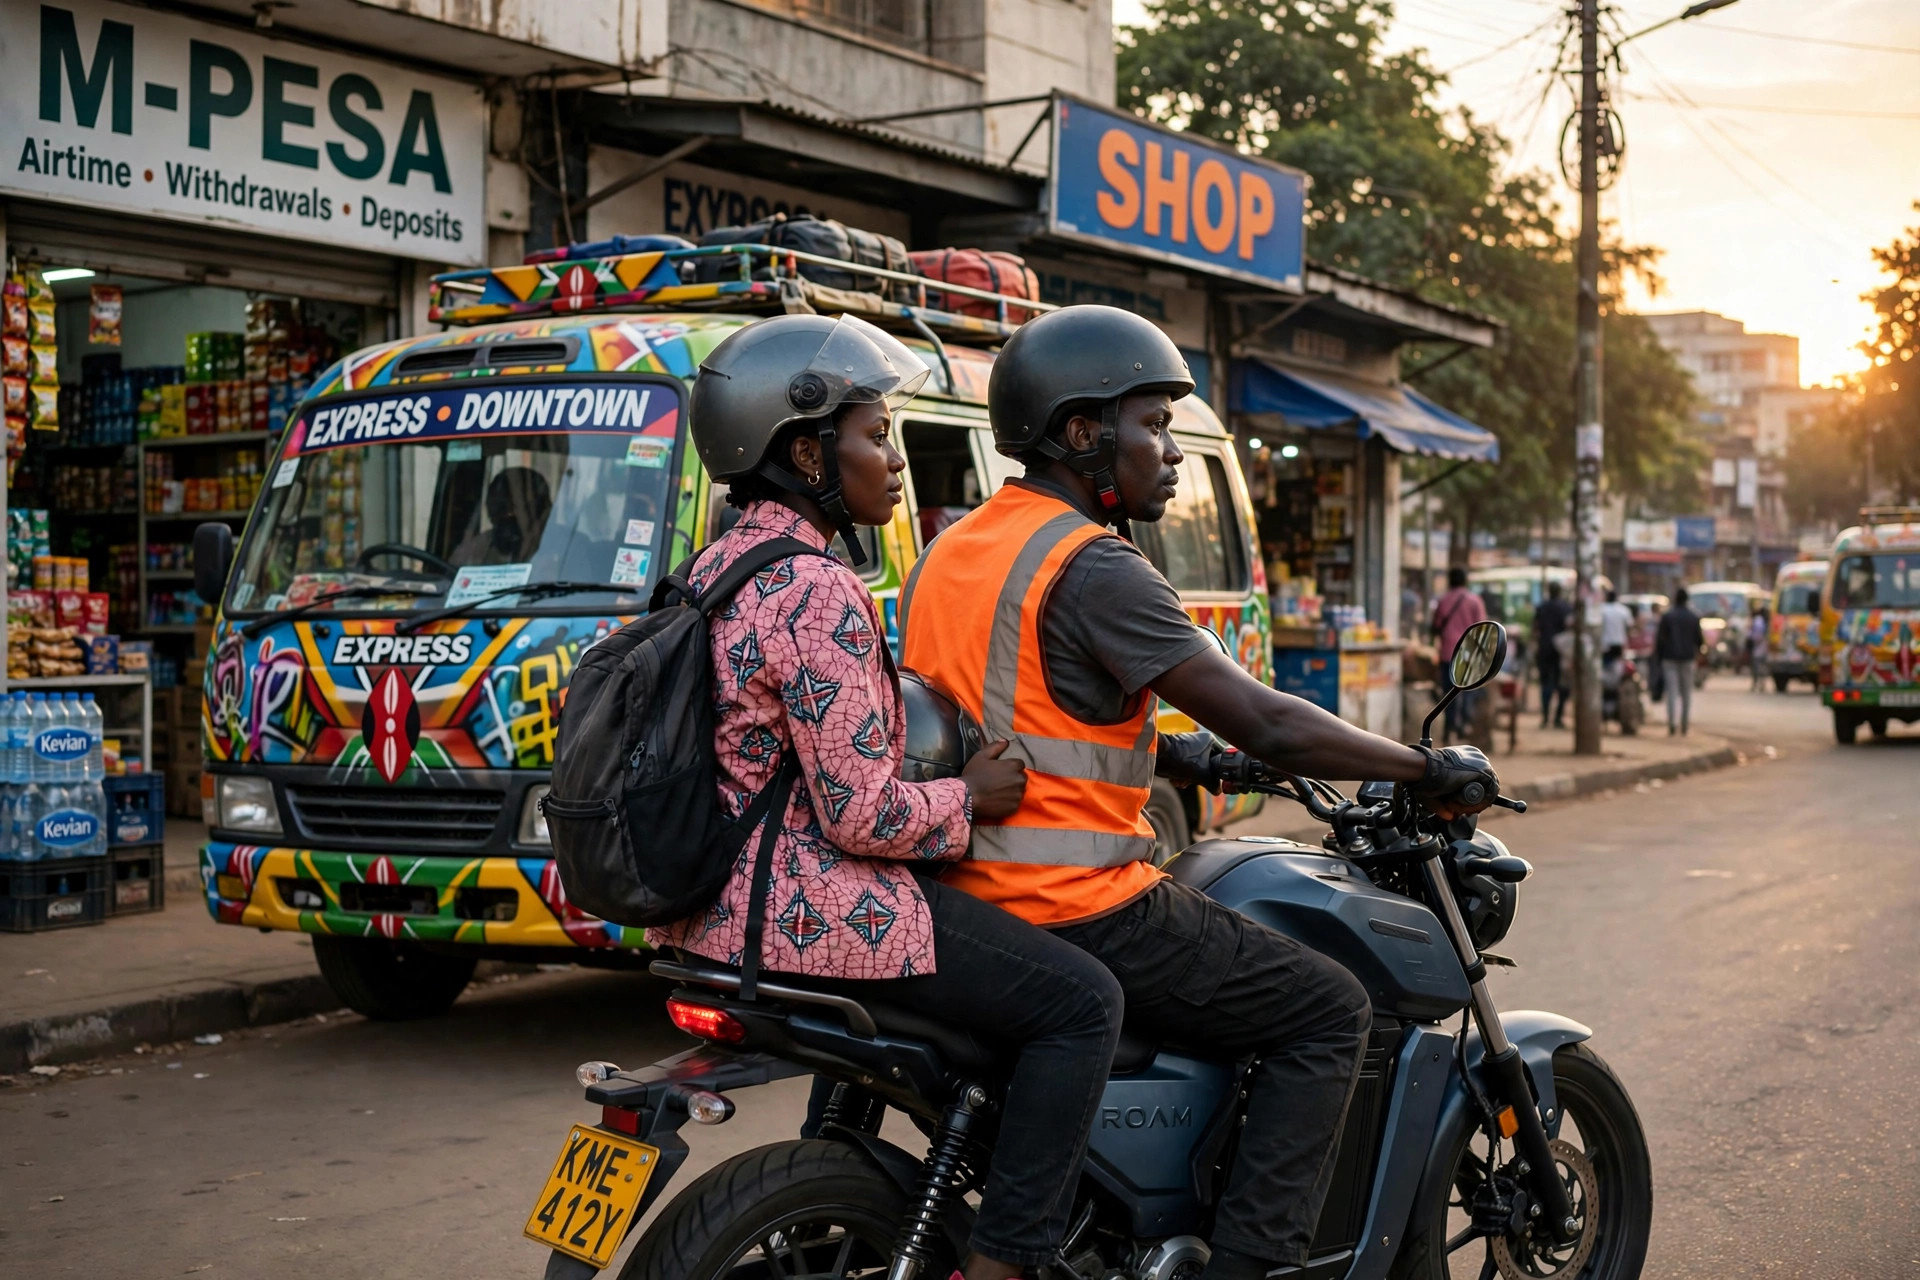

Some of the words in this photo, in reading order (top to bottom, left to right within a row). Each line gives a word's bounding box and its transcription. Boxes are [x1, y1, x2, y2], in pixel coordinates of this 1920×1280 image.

[39, 3, 454, 195] M-PESA
[18, 136, 132, 188] Airtime
[165, 160, 333, 221] Withdrawals
[360, 195, 464, 243] Deposits
[1096, 128, 1275, 260] SHOP
[305, 395, 432, 448] EXPRESS
[455, 387, 652, 431] DOWNTOWN
[332, 634, 473, 665] EXPRESS
[41, 732, 87, 753] Kevian
[43, 816, 92, 839] Kevian
[1101, 1105, 1193, 1129] ROAM
[556, 1137, 630, 1197] KME
[537, 1186, 625, 1255] 412Y
